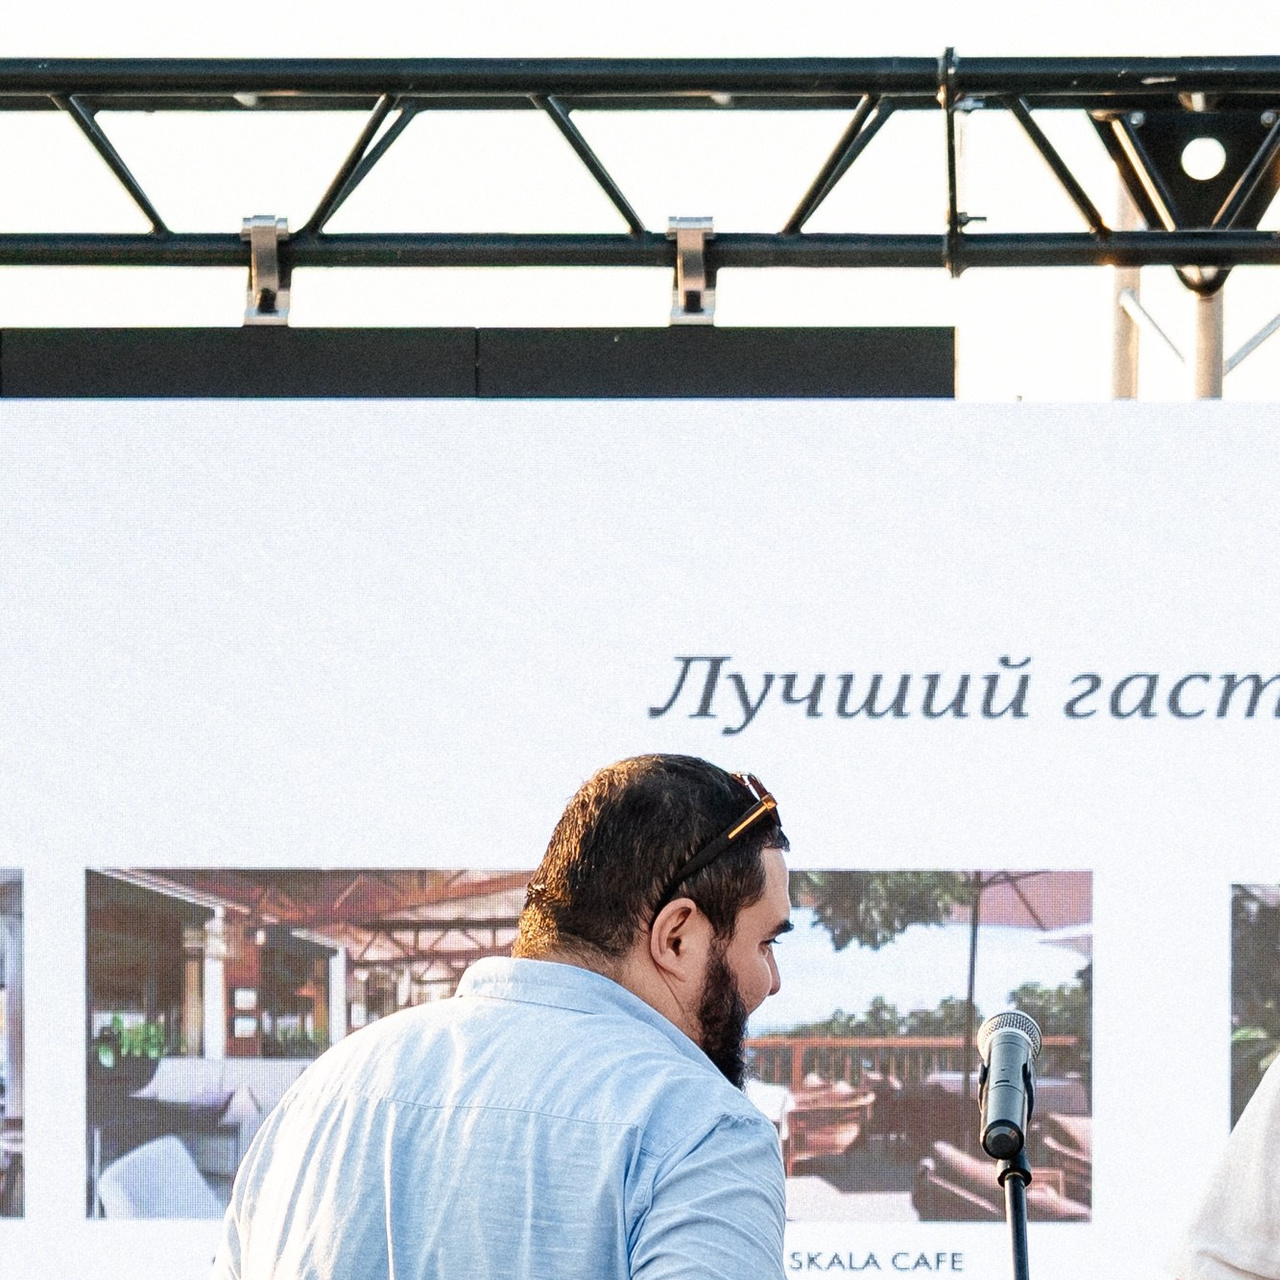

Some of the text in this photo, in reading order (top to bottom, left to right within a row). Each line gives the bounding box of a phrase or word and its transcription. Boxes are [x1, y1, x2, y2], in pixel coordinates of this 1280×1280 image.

[648, 655, 1032, 736] Лучший
[789, 1251, 964, 1271] SKALA CAFE
